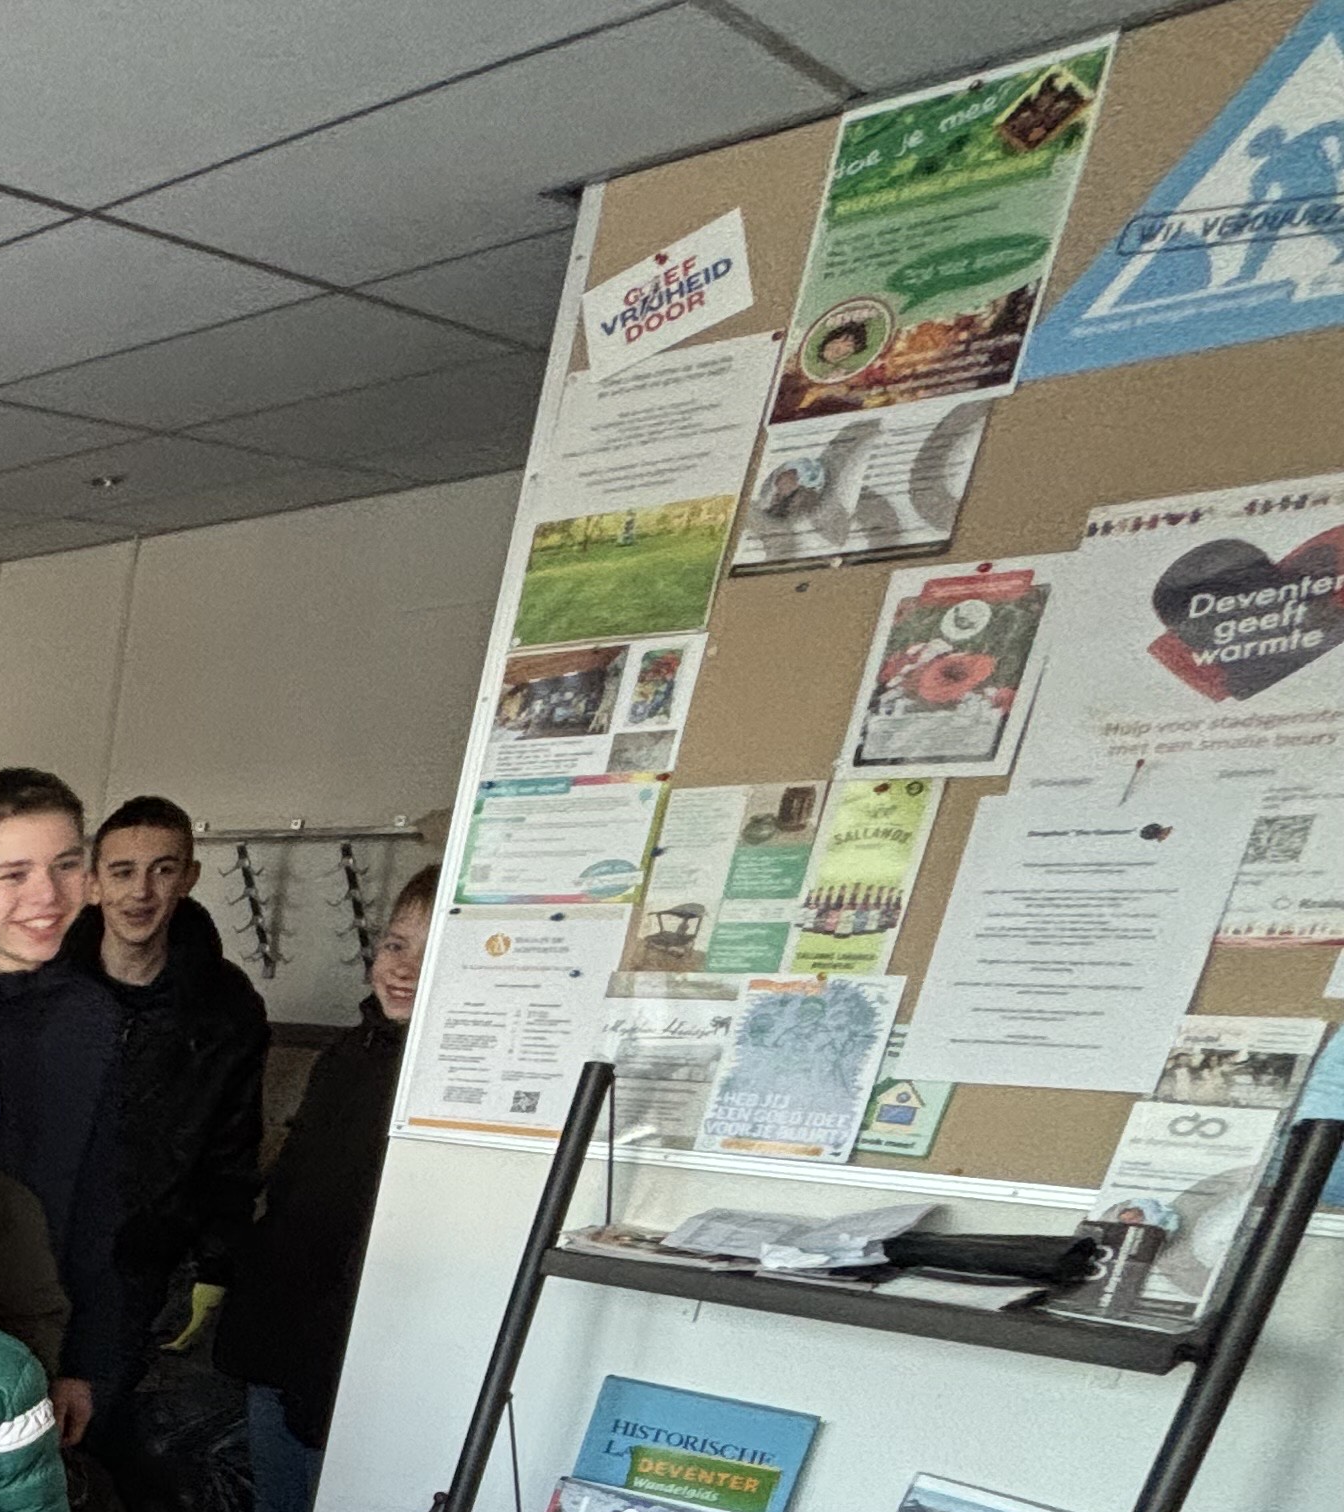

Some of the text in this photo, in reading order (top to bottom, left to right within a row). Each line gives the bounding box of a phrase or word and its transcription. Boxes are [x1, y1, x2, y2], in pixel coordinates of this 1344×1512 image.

[600, 257, 734, 336] VRIJHEID
[624, 290, 706, 344] DOOR
[1212, 601, 1308, 646] geeft
[1191, 627, 1326, 667] warmte
[631, 1476, 720, 1502] Wandelgids
[636, 1458, 761, 1494] DEVENTER
